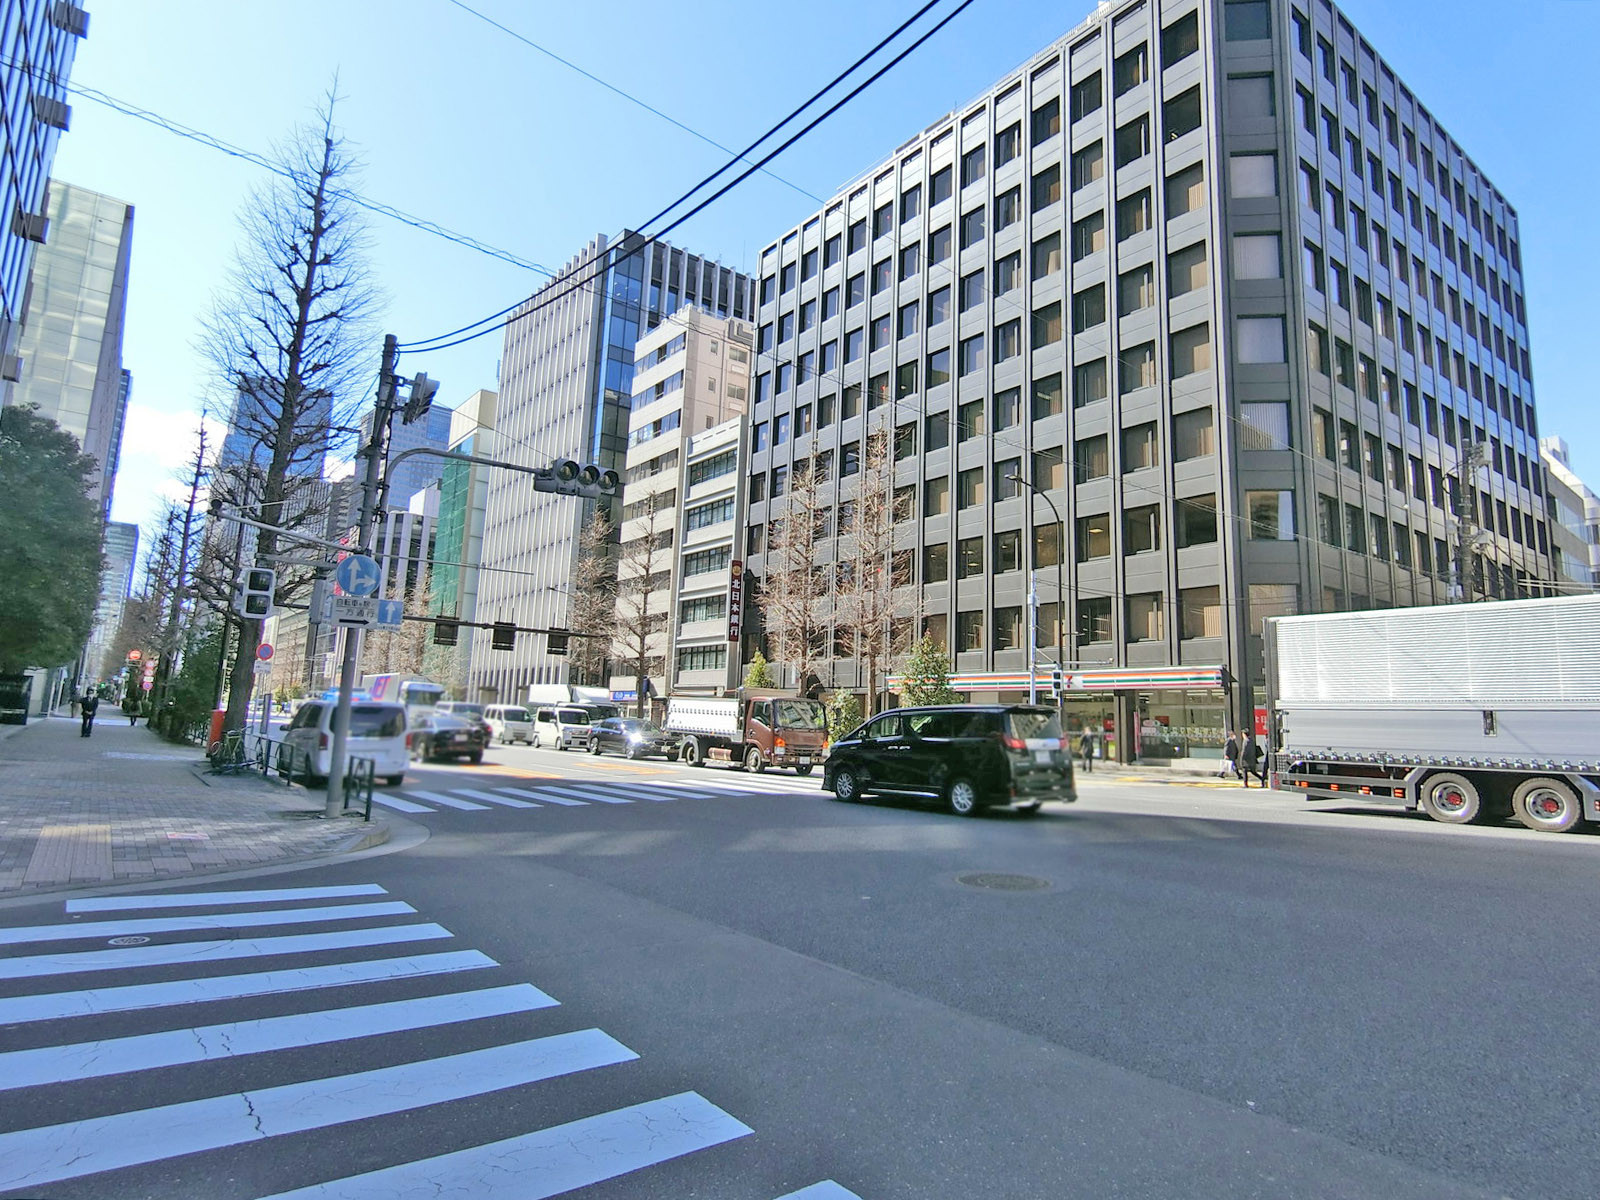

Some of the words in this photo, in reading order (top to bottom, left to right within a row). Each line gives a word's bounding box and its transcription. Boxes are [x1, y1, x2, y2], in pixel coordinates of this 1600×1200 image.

[730, 579, 740, 636] 北日本銀行
